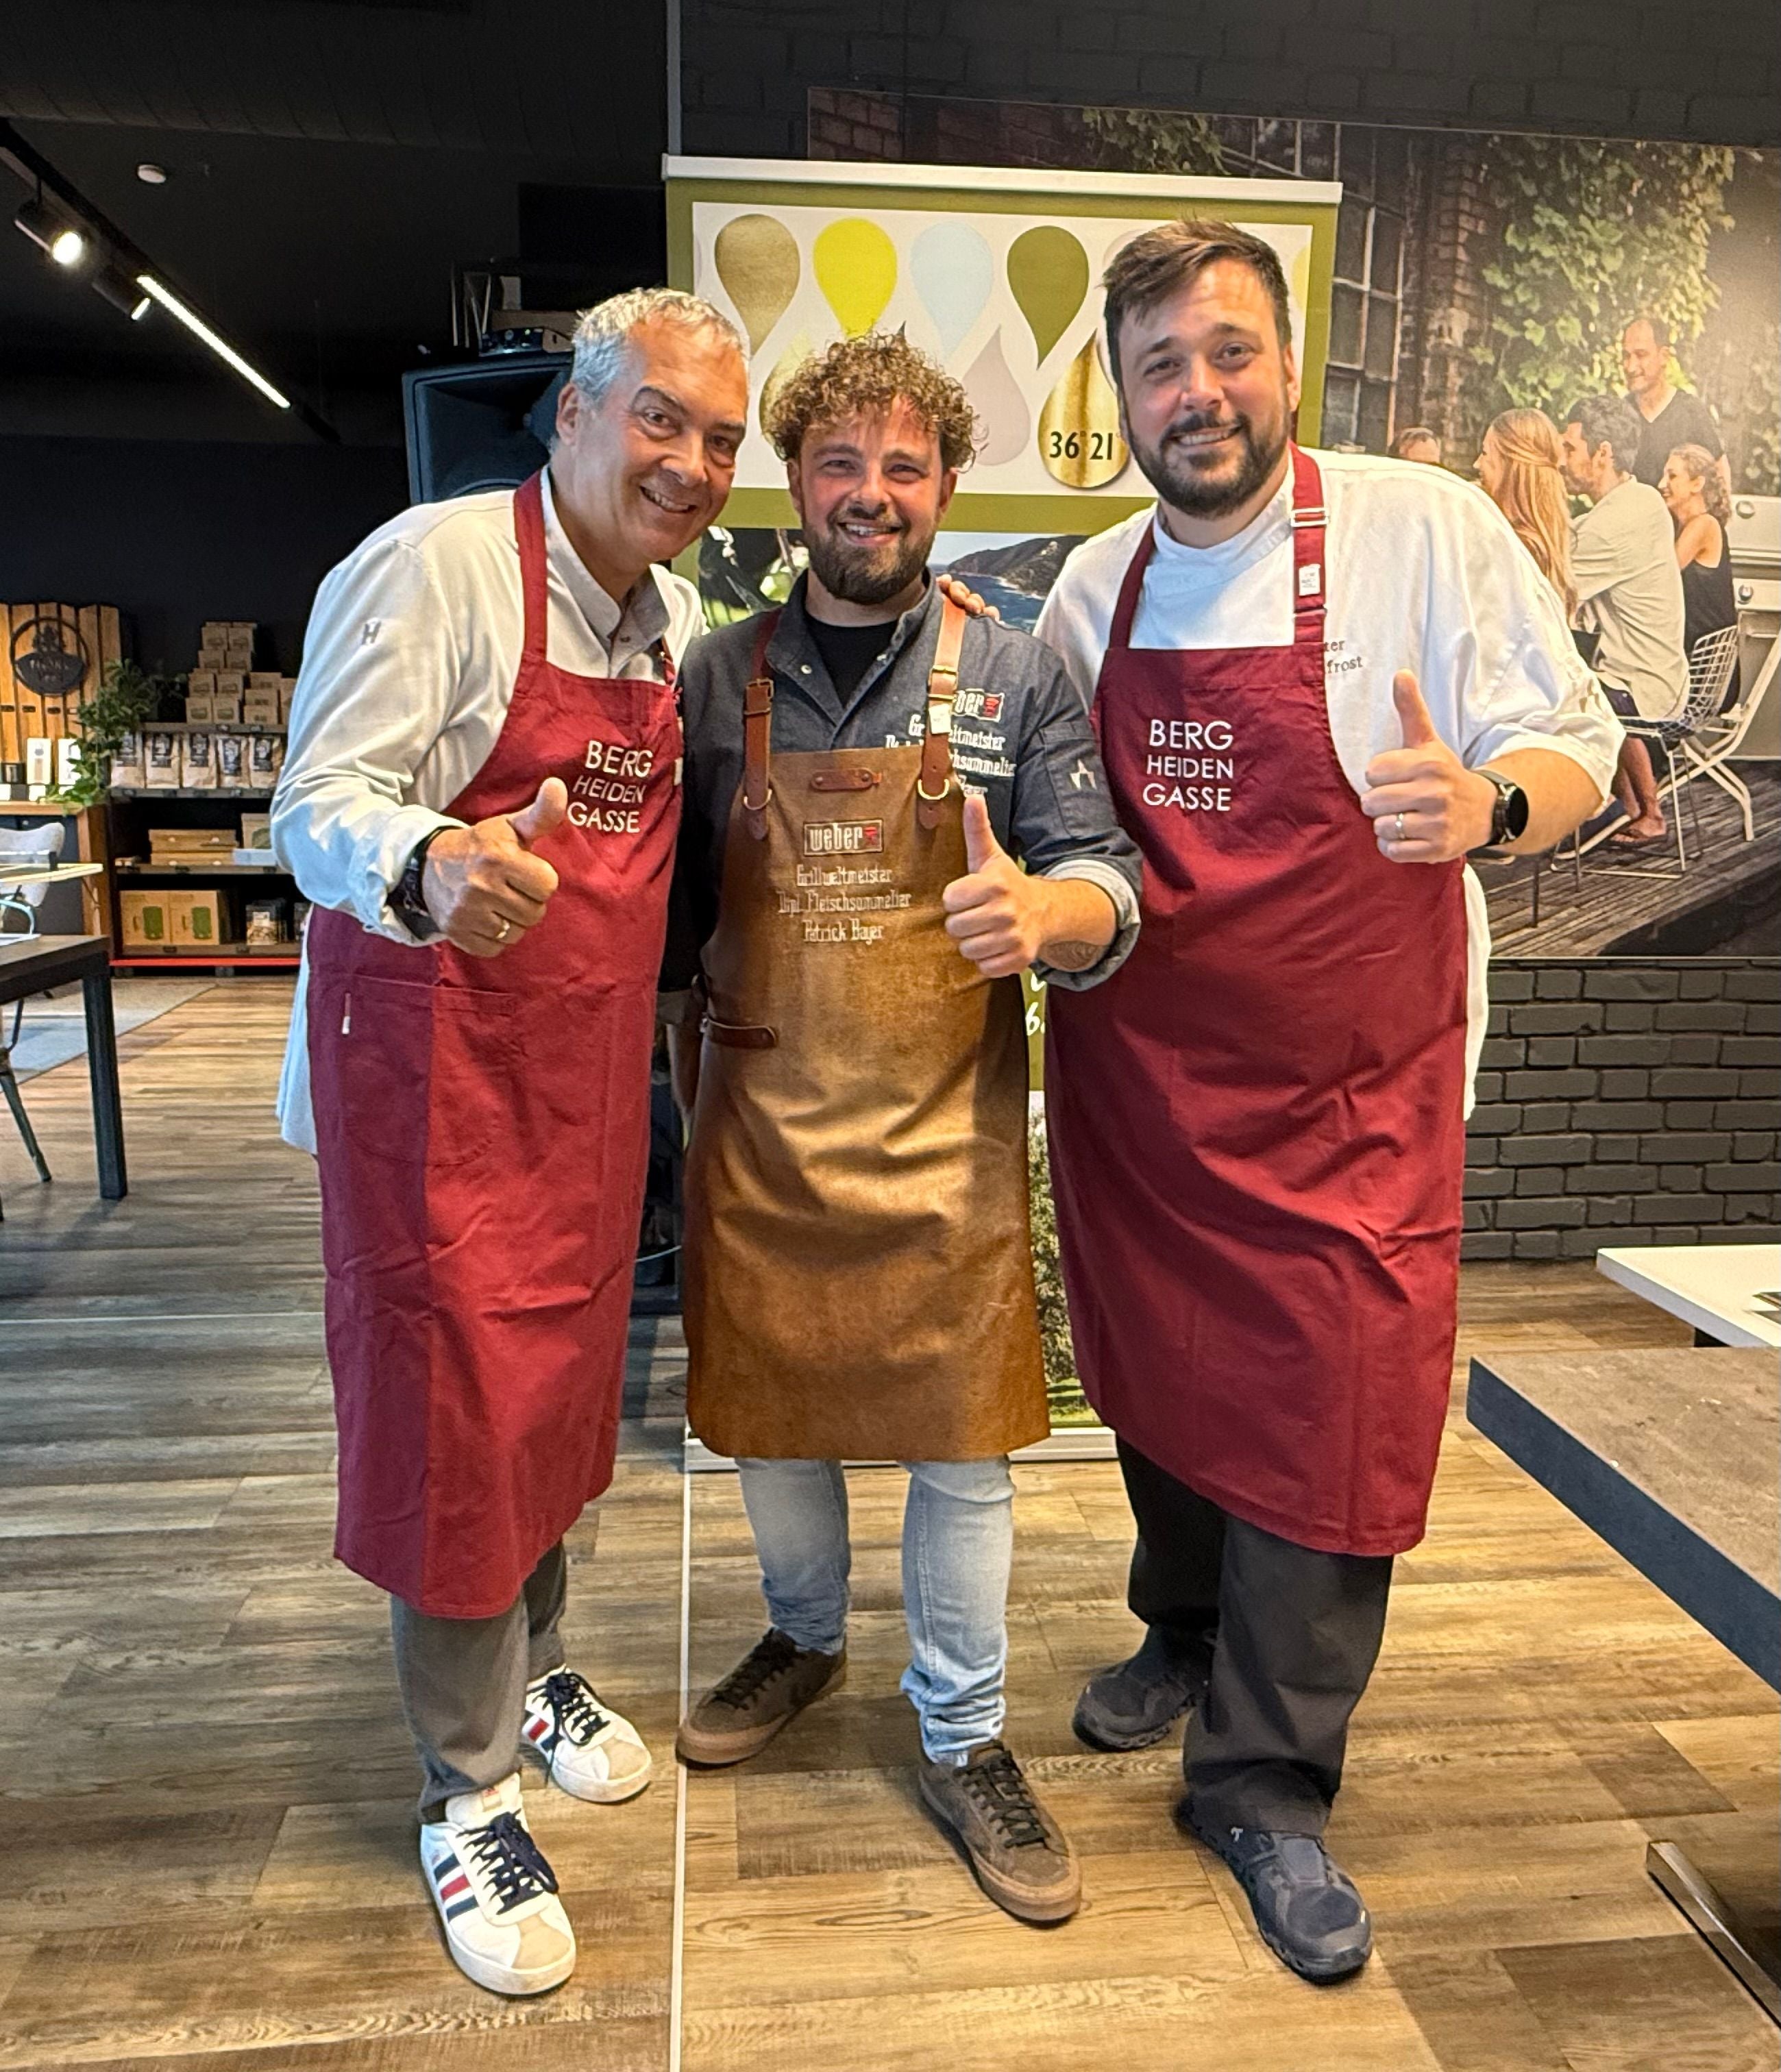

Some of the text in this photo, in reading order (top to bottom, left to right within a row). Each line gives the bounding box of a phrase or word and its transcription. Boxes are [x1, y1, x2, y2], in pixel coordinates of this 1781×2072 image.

[1325, 640, 1345, 652] ter
[1325, 656, 1364, 674] frost
[1149, 719, 1233, 751] BERG
[585, 740, 653, 778] BERG
[1146, 754, 1233, 780] HEIDEN
[572, 775, 646, 804] HEIDEN
[1142, 782, 1231, 812] GASSE
[567, 802, 641, 834] GASSE
[809, 822, 863, 851] weber
[806, 889, 912, 913] Fleischsommelier
[802, 917, 885, 946] Patrick Bayer
